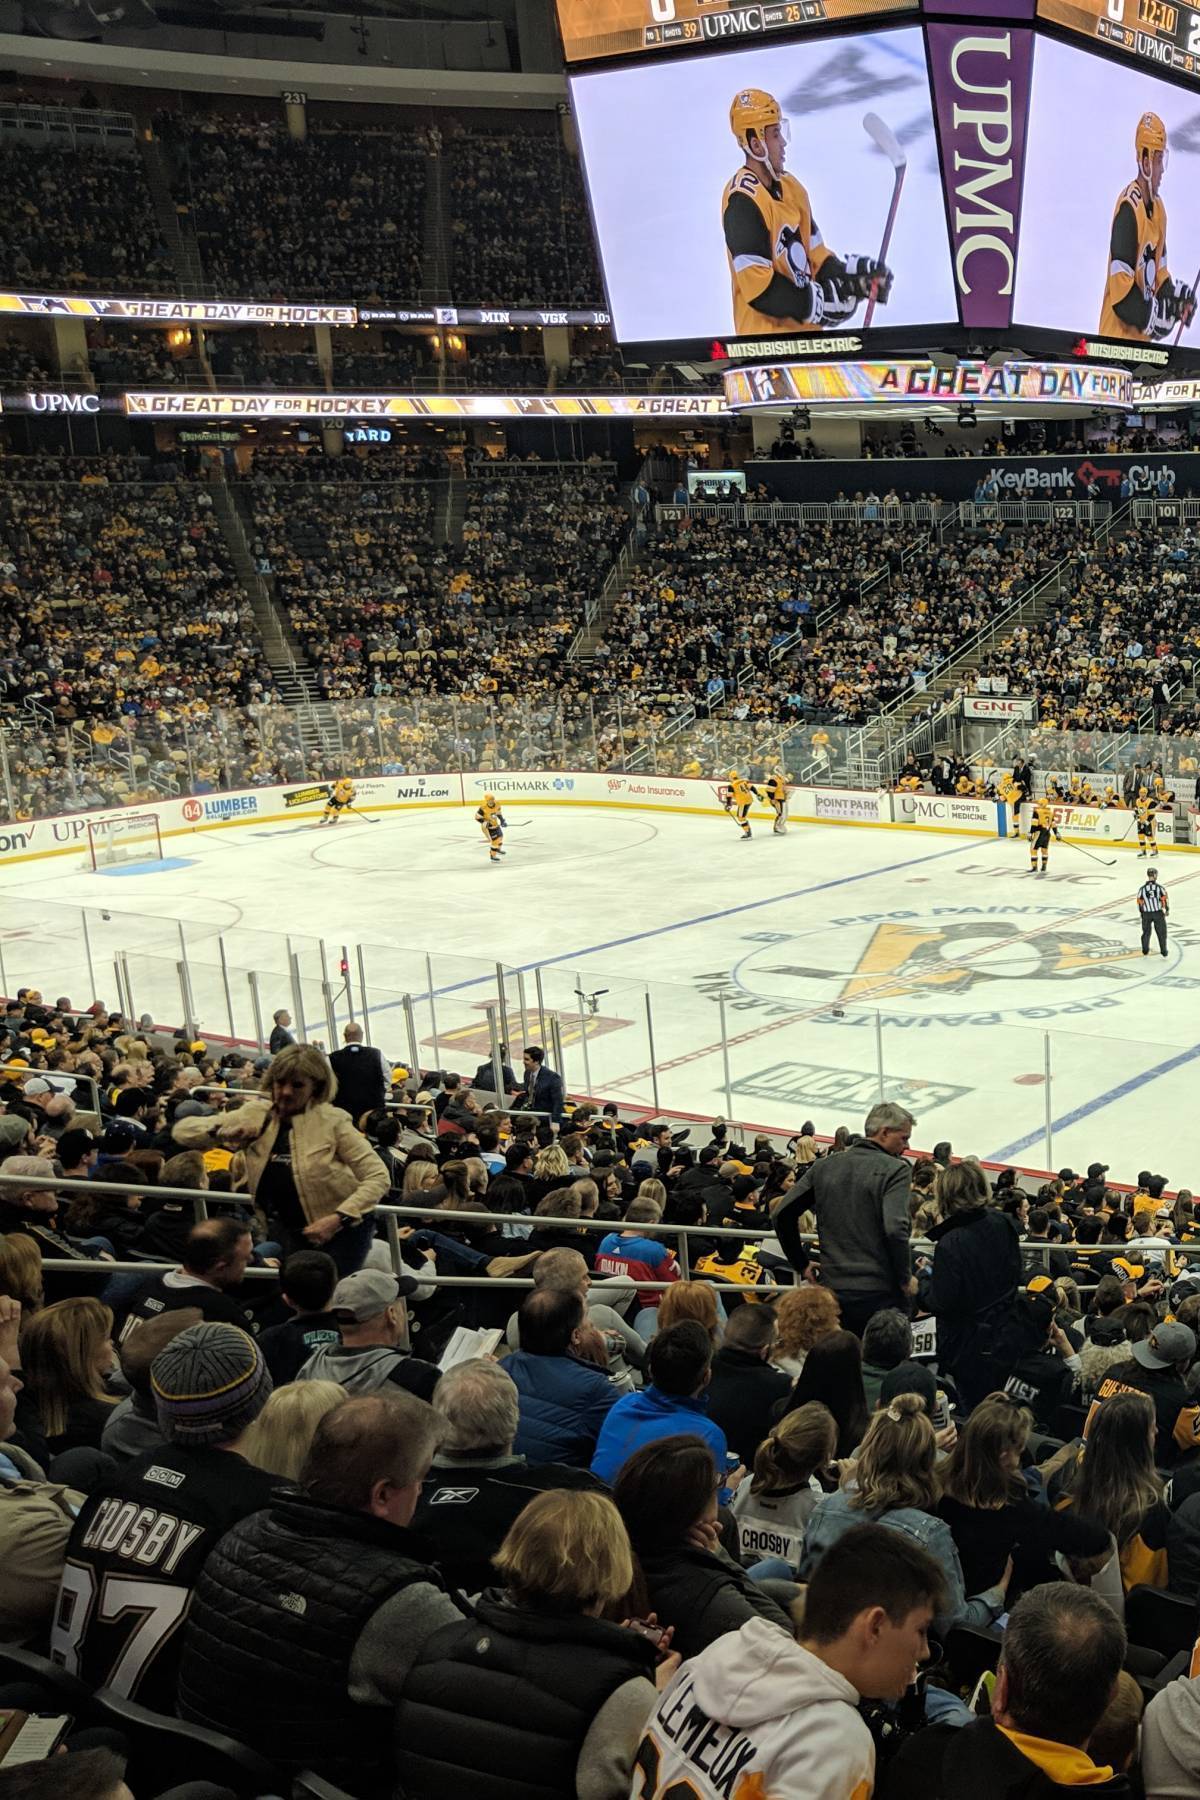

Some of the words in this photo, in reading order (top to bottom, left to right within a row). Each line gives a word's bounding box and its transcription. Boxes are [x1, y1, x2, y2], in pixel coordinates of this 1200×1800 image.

[765, 12, 783, 22] SHOTS
[786, 6, 800, 22] 25
[1141, 0, 1175, 32] 12:10
[664, 28, 682, 38] SHOTS
[683, 22, 697, 38] 39
[703, 10, 761, 37] UPMC
[1124, 31, 1134, 46] 39
[1137, 34, 1172, 64] UPMC
[1185, 56, 1193, 70] 25
[284, 92, 306, 104] 231
[951, 32, 1015, 294] UPMC
[126, 303, 197, 318] GREAT
[202, 305, 241, 319] DAY
[247, 307, 273, 318] FOR
[371, 311, 397, 319] RAM
[481, 311, 510, 323] MIN
[540, 312, 568, 324] VGK
[726, 341, 797, 358] MITSUBISHI
[798, 337, 863, 354] ELECTRIC
[1090, 343, 1135, 361] MITSUBISHI
[1135, 347, 1170, 364] ELECTRIC
[881, 369, 899, 389] A
[906, 367, 1029, 395] GREAT
[1038, 371, 1089, 397] DAY
[1092, 374, 1117, 394] FOR
[1133, 383, 1164, 400] DAY
[1166, 384, 1190, 397] FOR
[29, 393, 100, 412] UPMC
[135, 398, 148, 410] A
[151, 398, 226, 414] GREAT
[231, 398, 270, 414] DAY
[274, 400, 302, 410] FOR
[306, 398, 392, 414] HOCKEY
[636, 400, 647, 412] A
[650, 399, 713, 414] GREAT
[321, 418, 345, 429] 120
[991, 467, 1076, 489] KeyBank
[662, 509, 682, 521] 121
[1055, 506, 1074, 519] 122
[1159, 506, 1176, 518] 101
[973, 701, 1023, 712] GNC
[397, 788, 449, 799] NHL.COM
[483, 779, 550, 792] HIGHMARK
[627, 784, 647, 794] Auto
[648, 786, 686, 797] Insurance
[184, 803, 200, 818] 84
[204, 796, 258, 816] LUMBER
[817, 796, 850, 809] POINT
[850, 799, 879, 811] PARK
[901, 798, 945, 818] UPMC
[951, 804, 980, 813] SPORTS
[951, 812, 988, 822] MEDICINE
[1157, 822, 1172, 834] Ba
[829, 909, 919, 927] PPG
[931, 904, 1086, 916] PAINTS
[1018, 997, 1123, 1020] PPG
[147, 1467, 184, 1487] CCM
[82, 1497, 205, 1575] CROSBY
[742, 1529, 790, 1557] CROSBY
[51, 1557, 194, 1701] 87
